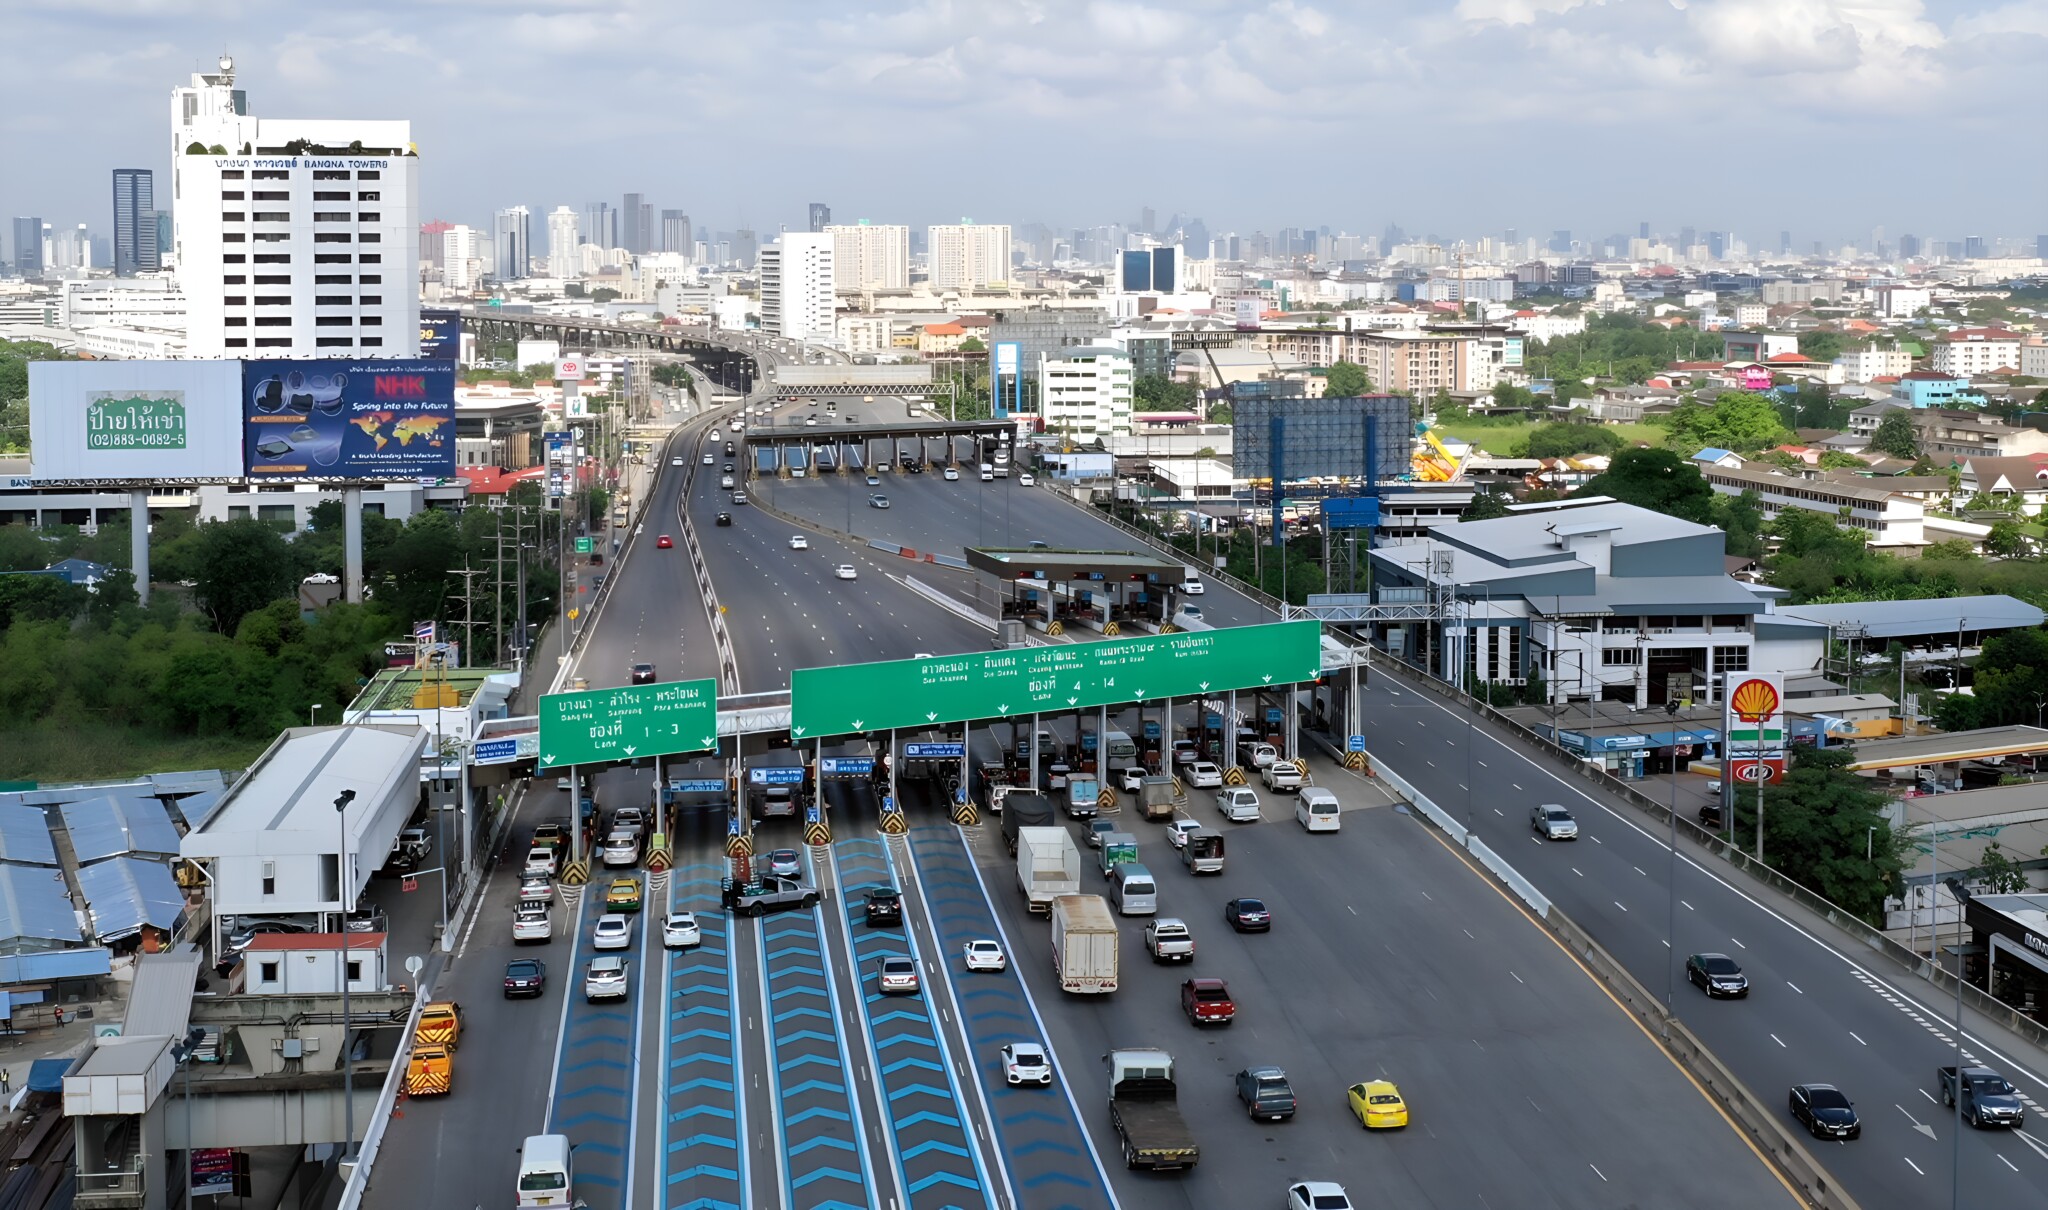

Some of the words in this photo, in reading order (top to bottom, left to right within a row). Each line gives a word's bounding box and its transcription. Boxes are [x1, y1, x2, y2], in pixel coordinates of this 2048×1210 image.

[304, 160, 344, 168] BANGNA
[374, 374, 426, 396] NHK
[89, 405, 184, 430] ป้ายให้เช่า
[352, 402, 381, 412] Spring
[383, 402, 402, 410] into
[404, 402, 419, 410] the
[421, 402, 449, 410] Future
[922, 662, 969, 674] ดาวคะนอง
[984, 656, 1016, 668] ดินแดง
[1034, 649, 1076, 663] แจ้งวัฒนะ
[1170, 636, 1214, 649] รามอินทรา
[1028, 673, 1056, 692] ช่องที่
[1073, 680, 1081, 691] 4
[1103, 676, 1115, 689] 14
[558, 699, 593, 712] บางนา
[610, 691, 640, 707] สำโรง
[656, 686, 699, 701] พระโขนง
[589, 716, 623, 738] ช่องที่
[644, 726, 649, 738] 1
[671, 723, 679, 735] 3
[594, 740, 617, 749] Lane
